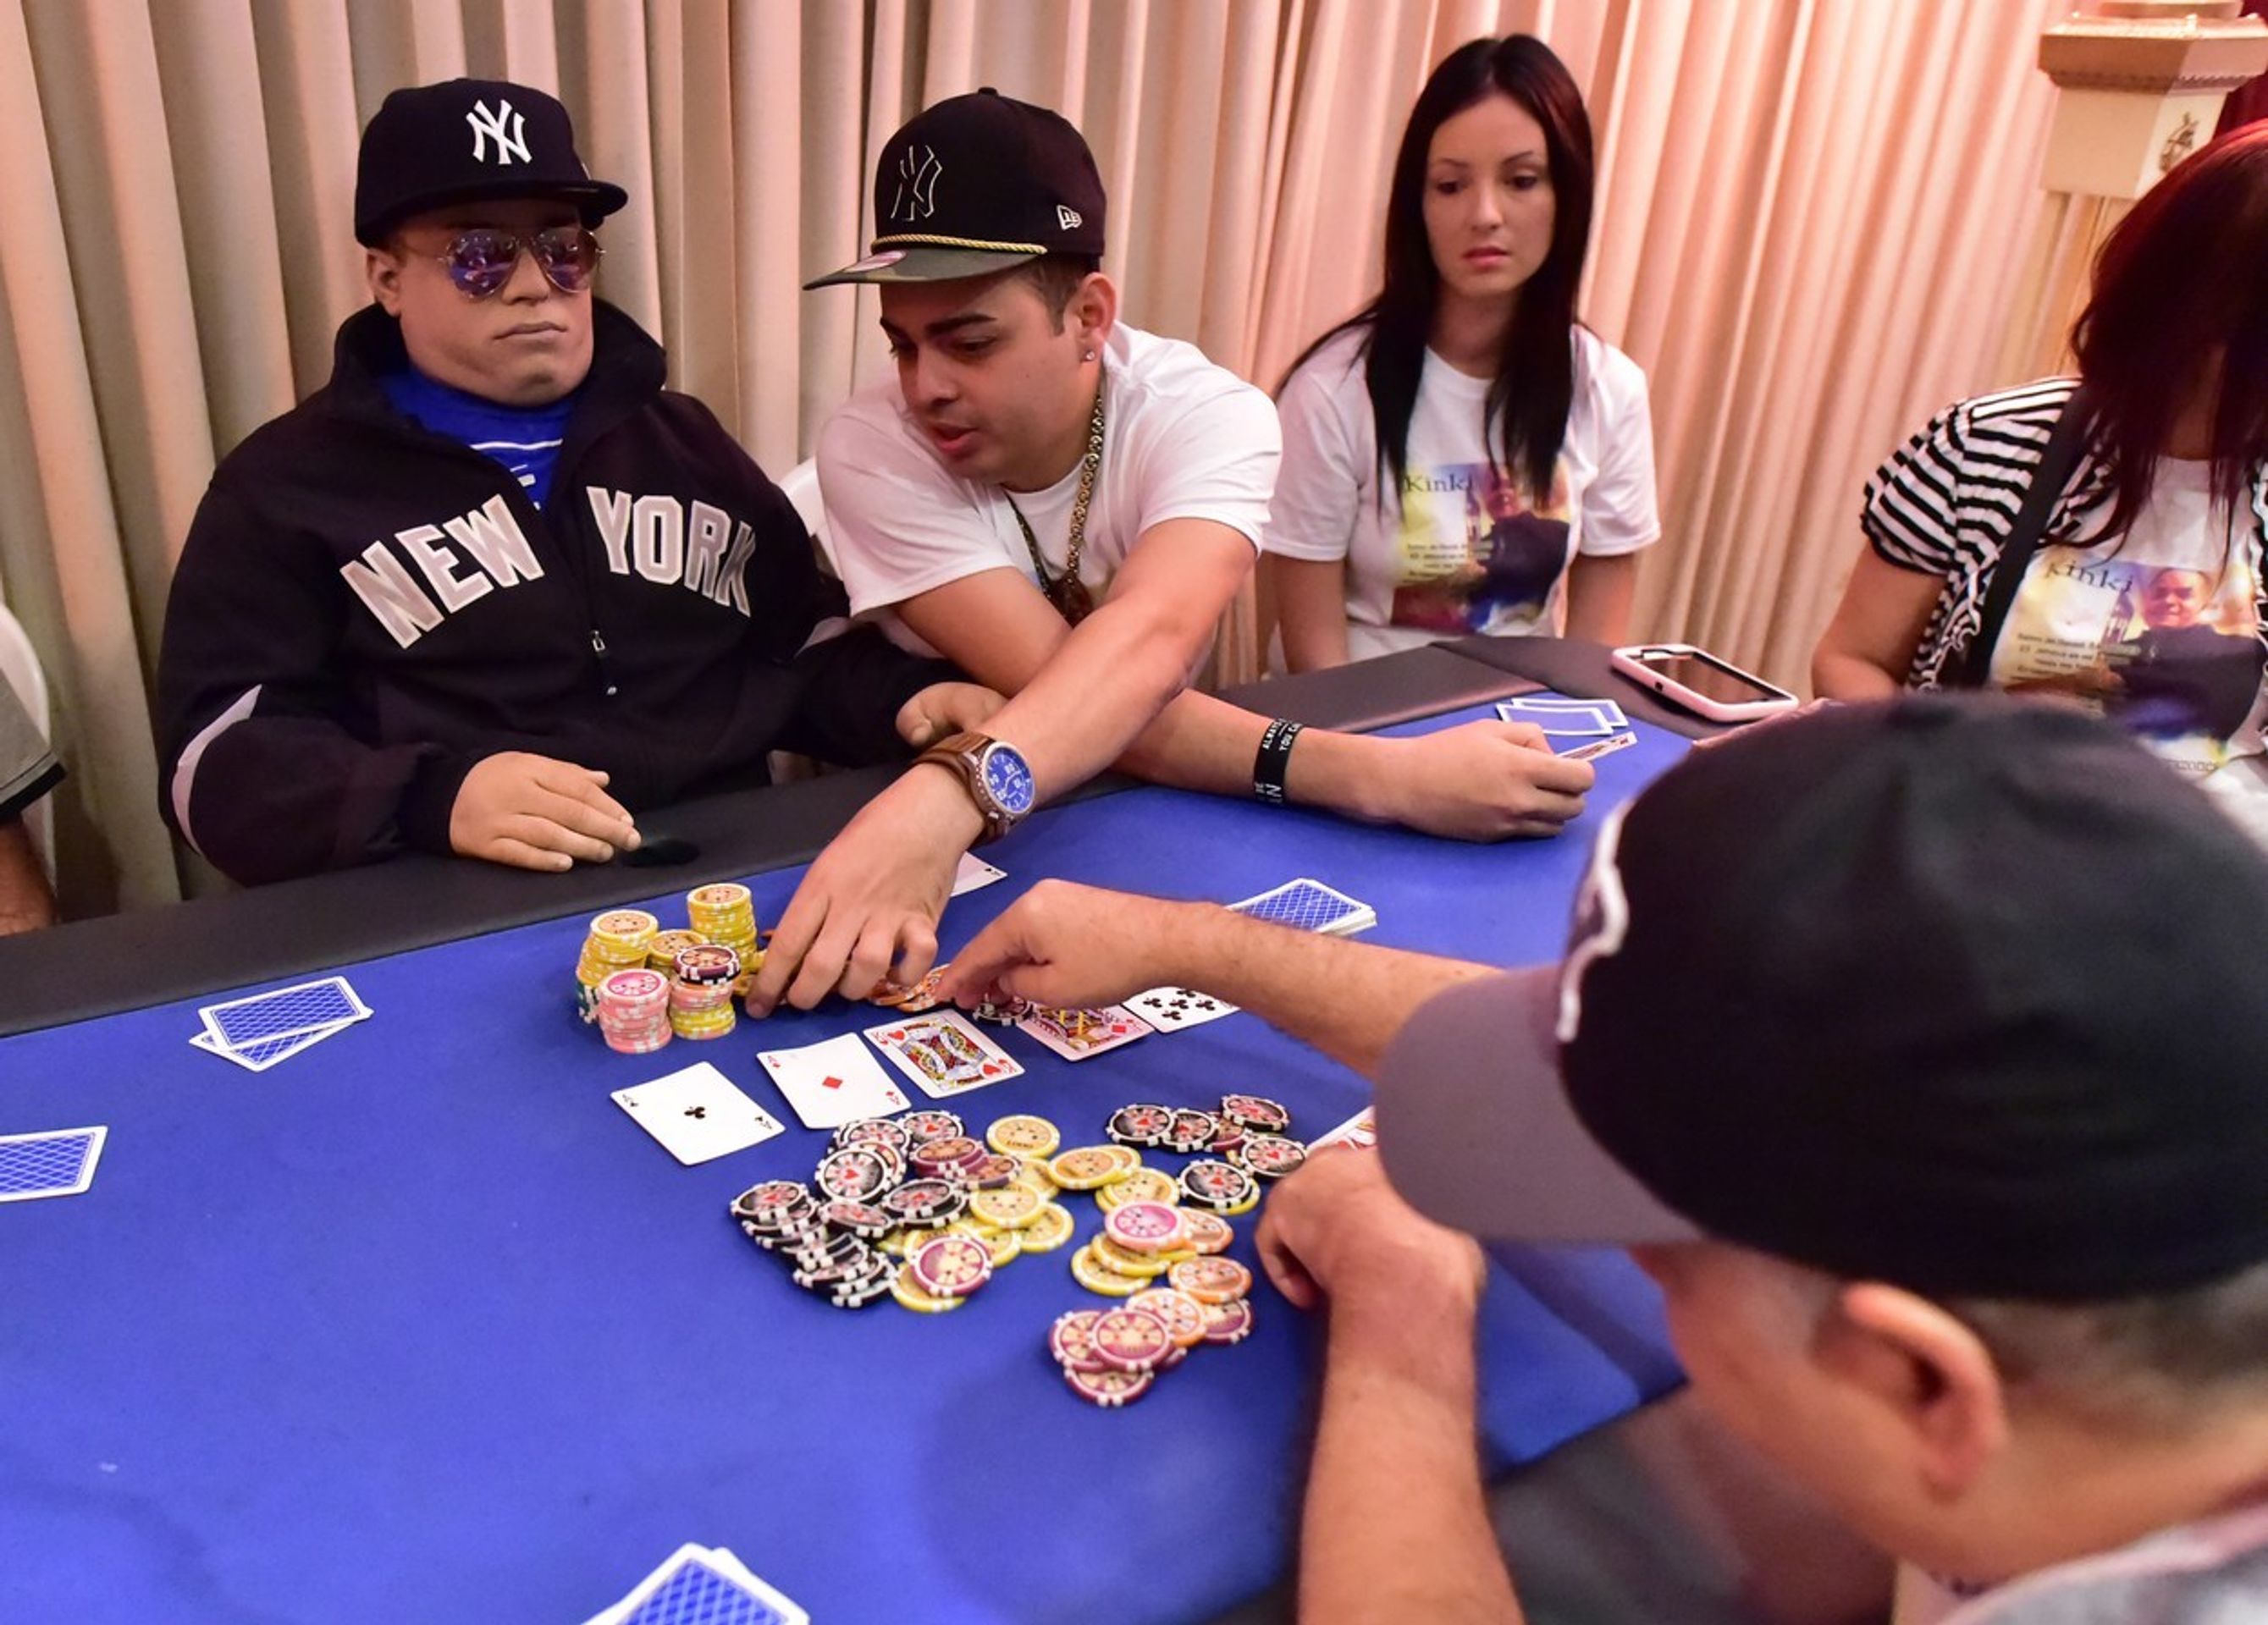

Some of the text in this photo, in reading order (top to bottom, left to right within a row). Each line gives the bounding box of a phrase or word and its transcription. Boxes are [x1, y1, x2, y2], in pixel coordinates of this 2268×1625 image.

[466, 99, 533, 165] NY
[339, 486, 752, 650] NEW YORK
